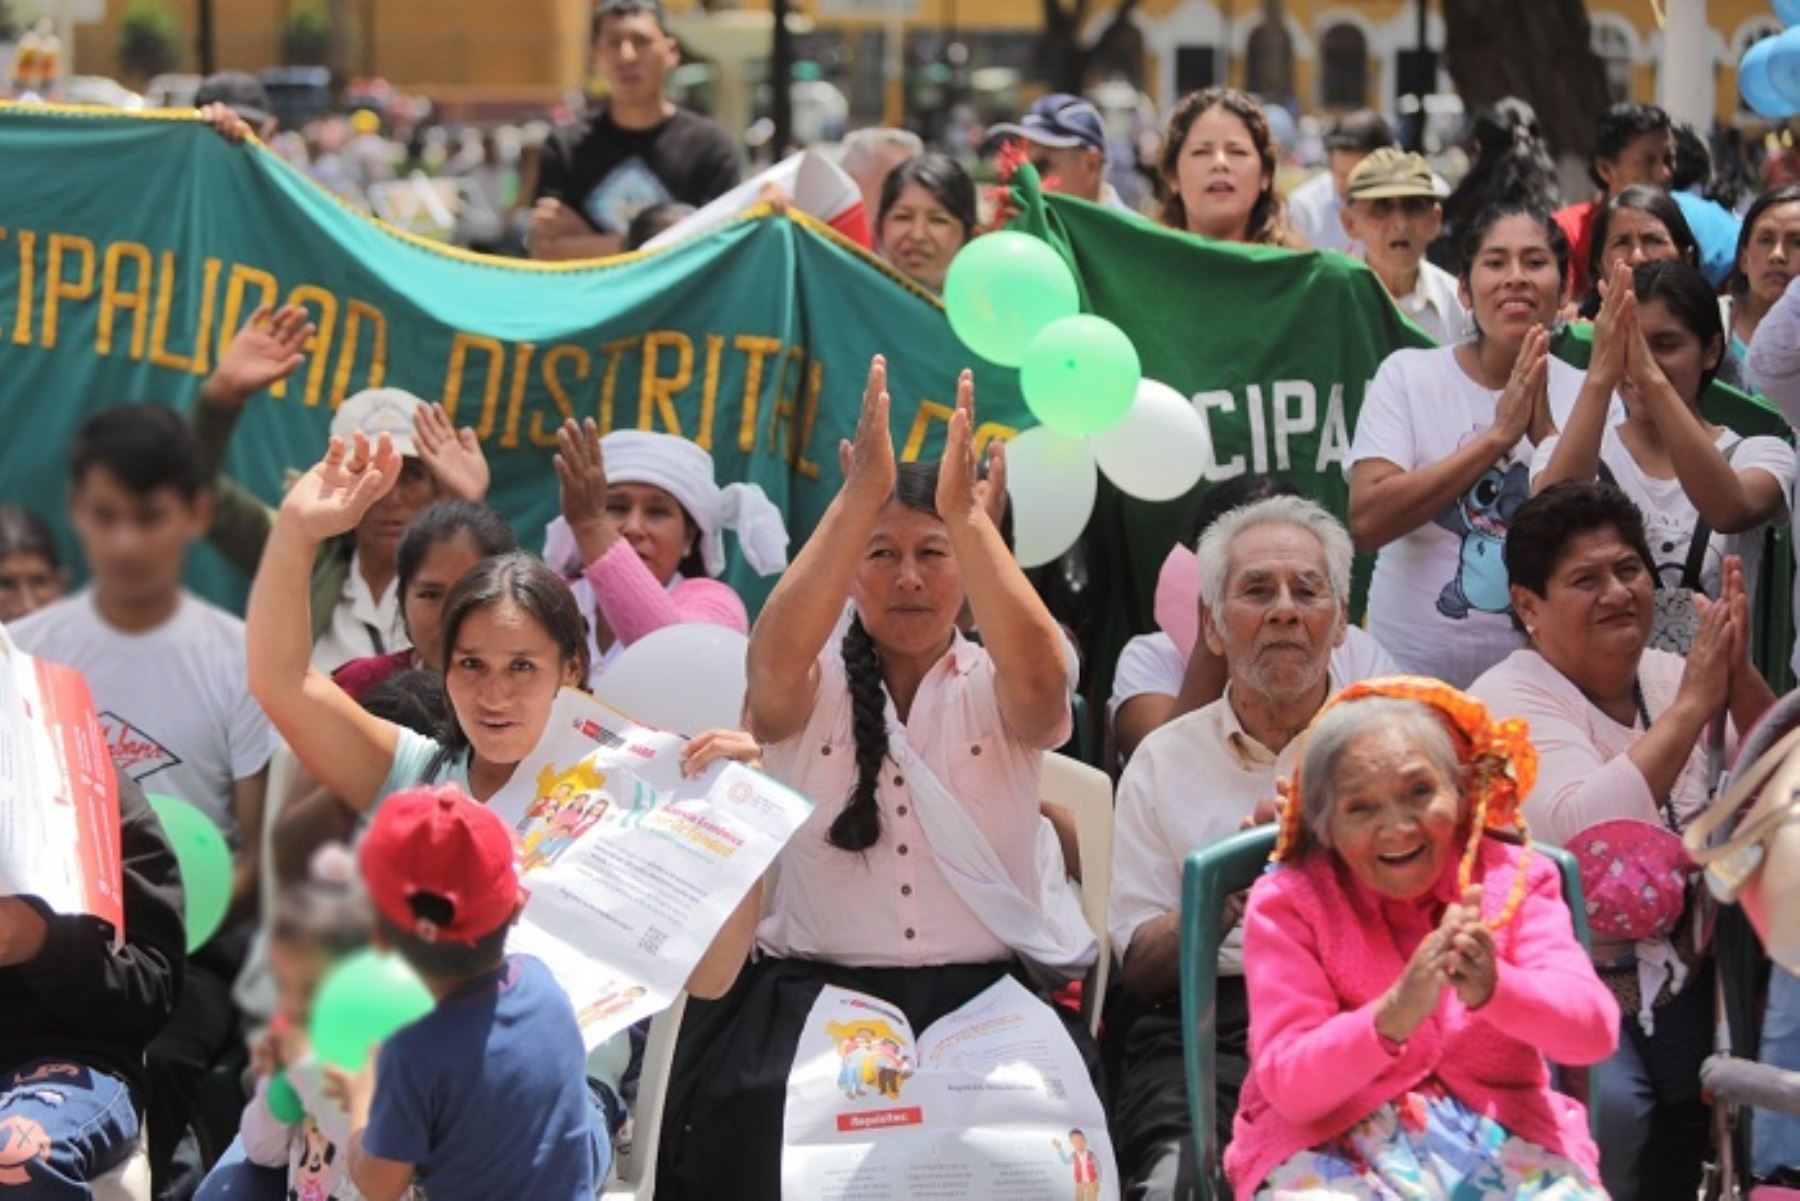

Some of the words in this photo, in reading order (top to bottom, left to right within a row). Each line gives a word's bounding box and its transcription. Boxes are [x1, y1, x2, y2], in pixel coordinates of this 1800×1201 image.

[0, 226, 389, 409] IPALIDAD
[443, 330, 823, 479] DISTRITAL
[1191, 379, 1372, 484] CIPA
